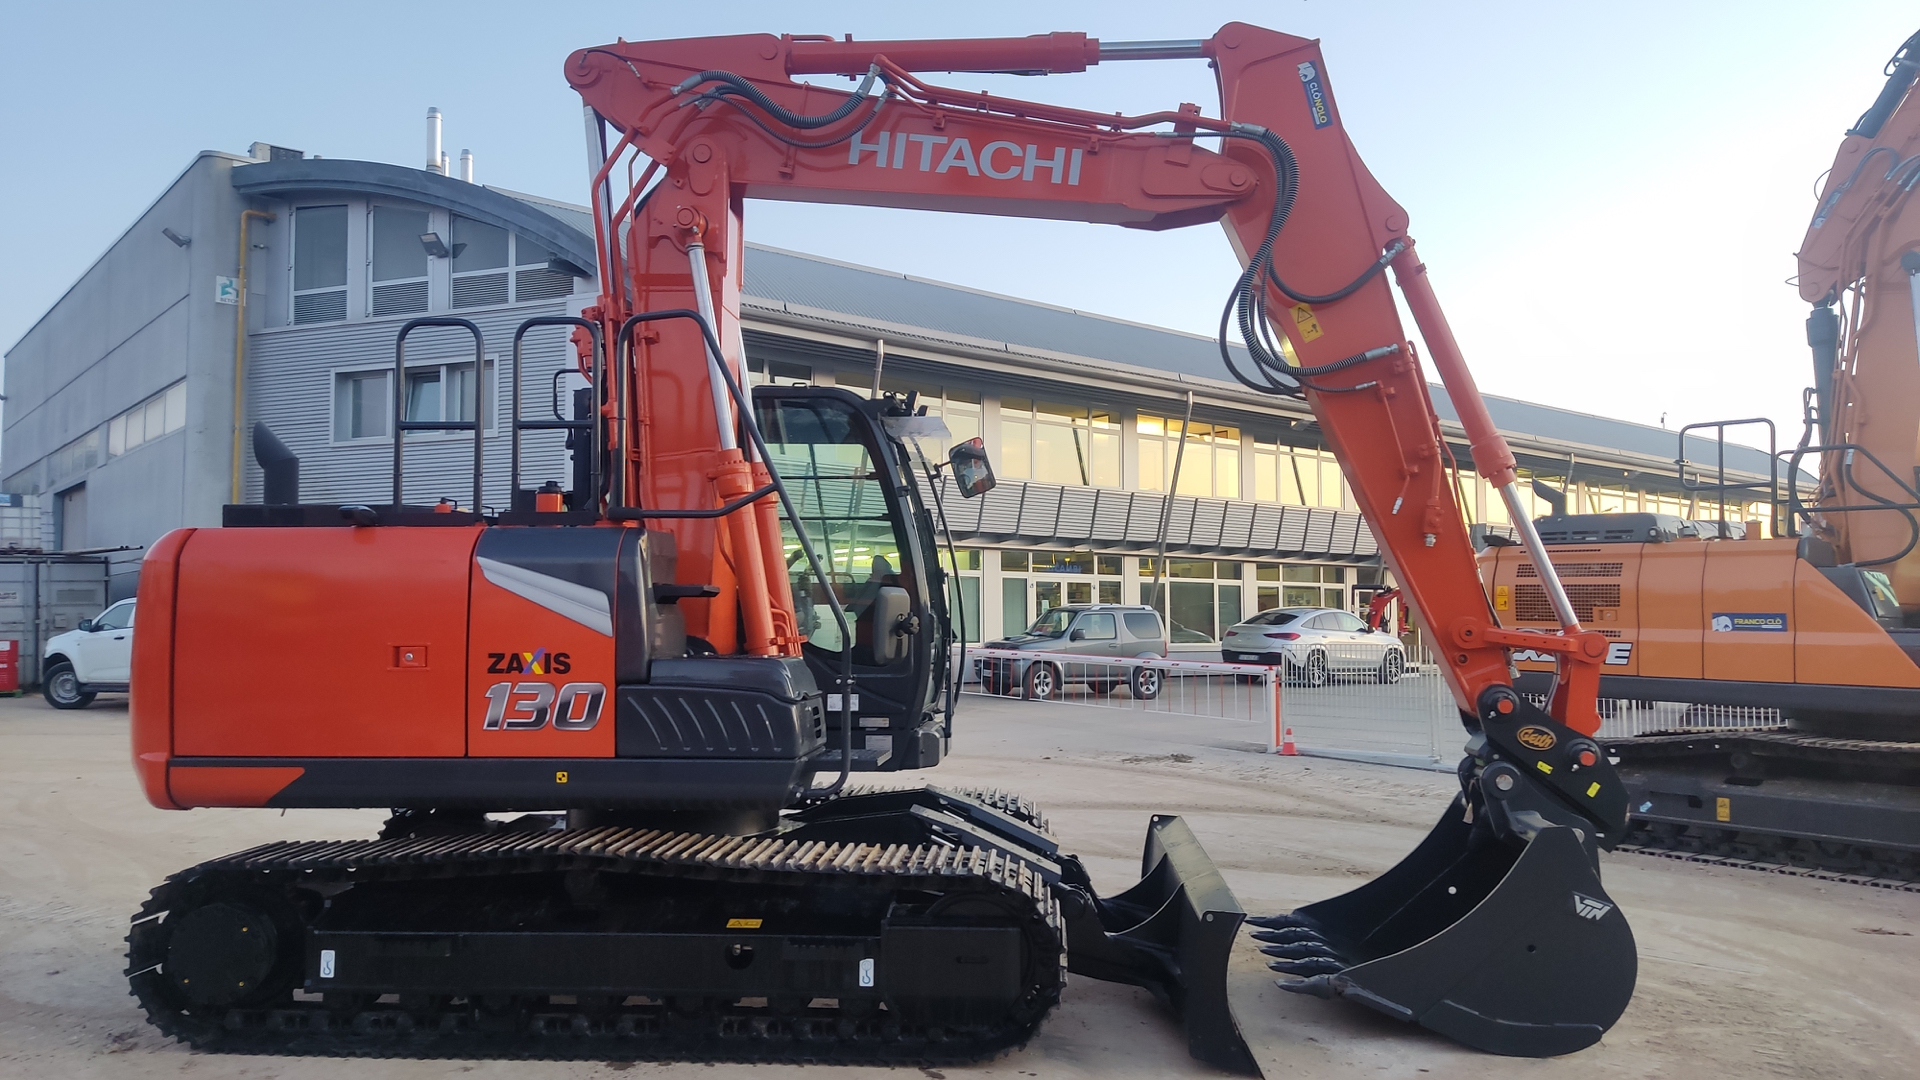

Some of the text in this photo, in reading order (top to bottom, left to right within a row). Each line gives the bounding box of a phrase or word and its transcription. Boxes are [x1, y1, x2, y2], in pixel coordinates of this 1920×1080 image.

[848, 131, 1082, 185] HITACHI
[487, 647, 571, 675] ZAXIS
[482, 682, 606, 731] 130
